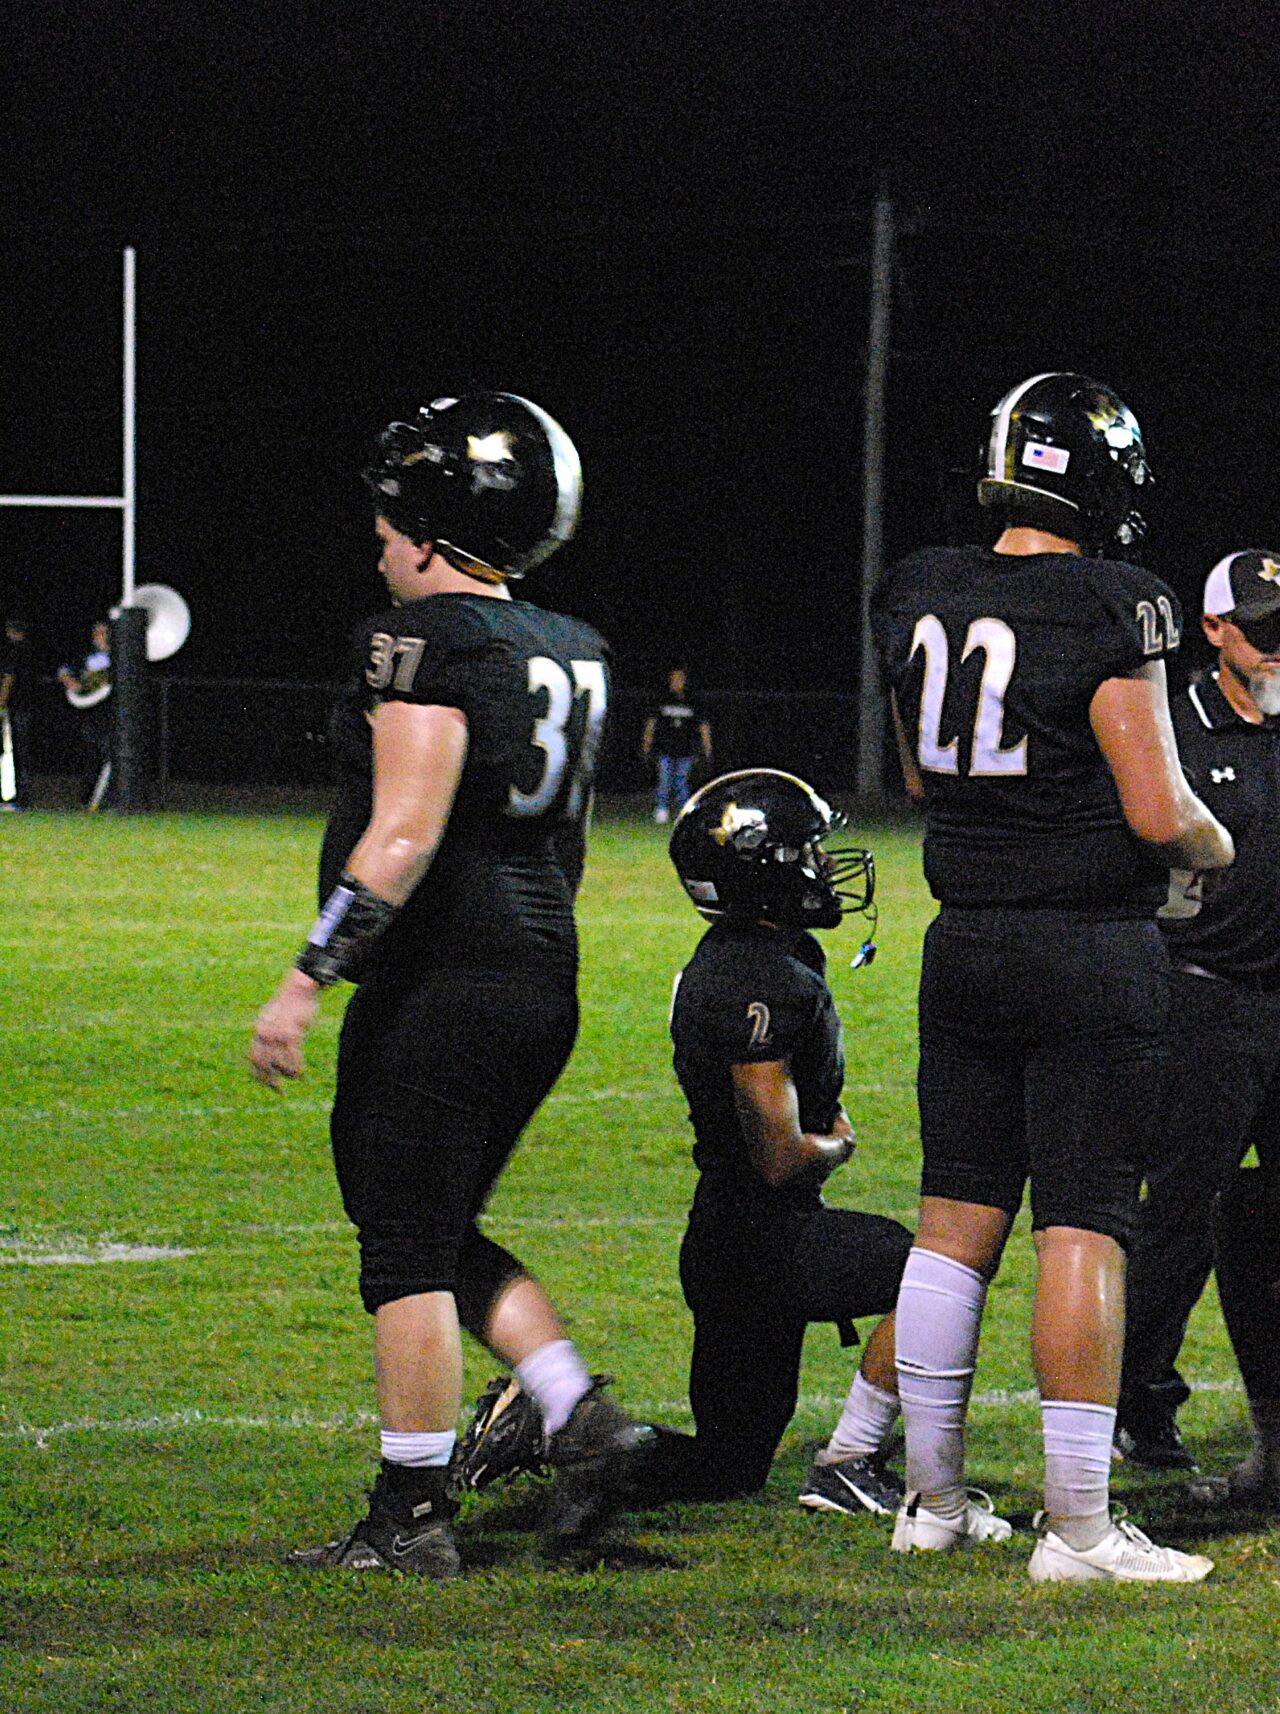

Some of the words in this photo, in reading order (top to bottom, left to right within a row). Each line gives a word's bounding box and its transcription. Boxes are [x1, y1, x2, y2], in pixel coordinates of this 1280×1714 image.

[1136, 595, 1181, 655] 22
[364, 631, 427, 693] 37
[908, 614, 1029, 777] 22
[506, 655, 608, 819] 37
[746, 1001, 773, 1050] 2
